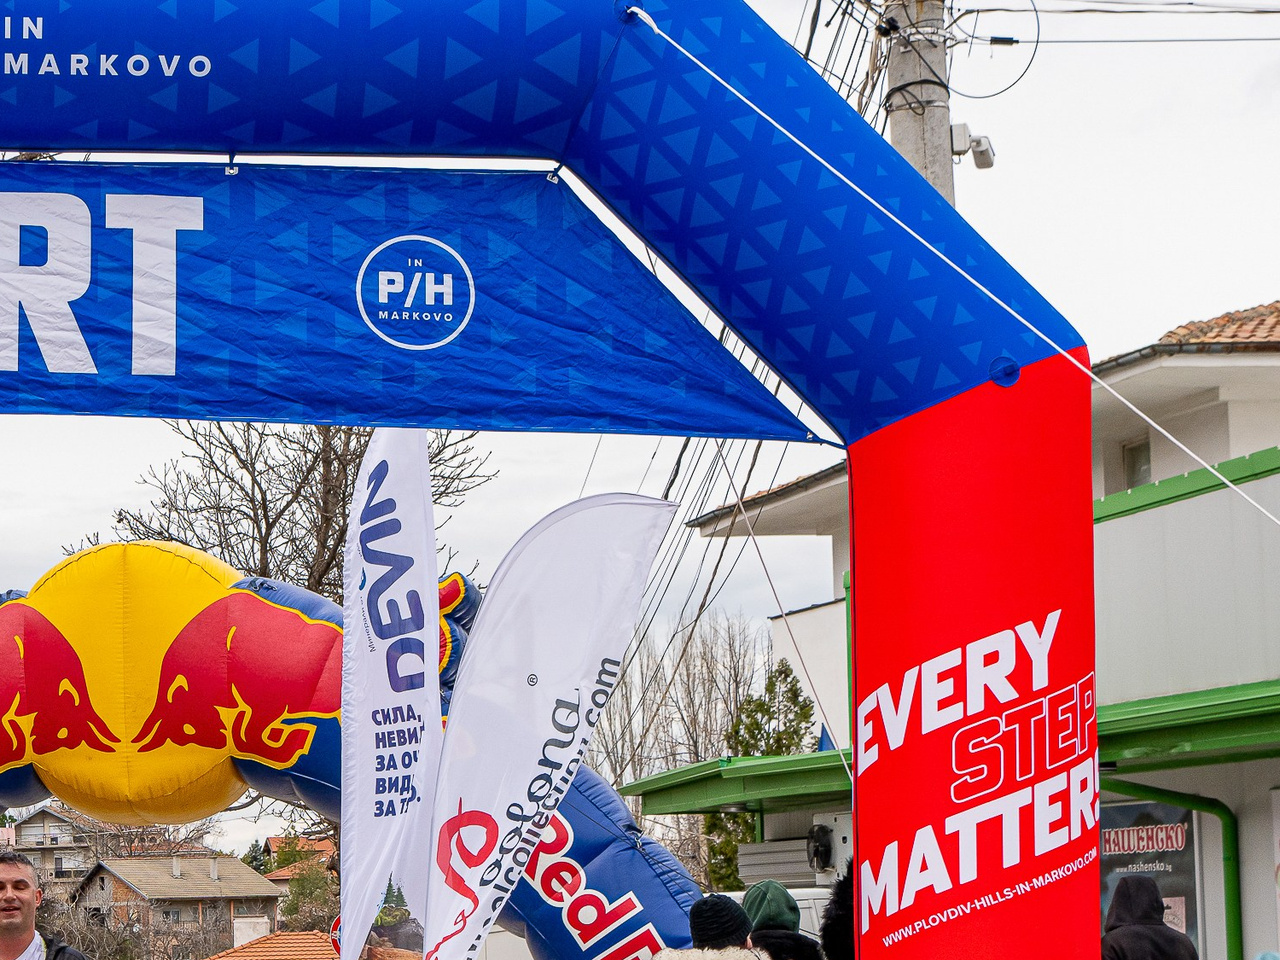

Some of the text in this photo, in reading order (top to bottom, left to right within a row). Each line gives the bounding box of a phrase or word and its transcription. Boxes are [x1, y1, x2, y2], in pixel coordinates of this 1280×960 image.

[4, 16, 44, 39] IN
[4, 54, 212, 77] MARKOVO
[408, 258, 423, 267] IN
[378, 271, 453, 308] P/H
[378, 311, 453, 322] MARKOVO
[359, 459, 425, 693] DEVIN
[857, 608, 1062, 778] EVERY
[950, 671, 1096, 804] STEP
[1102, 823, 1186, 856] НАШЕНСКО
[882, 846, 1098, 948] WWW.PLOVDIV-HILLS-IN-MARKOVO.COM
